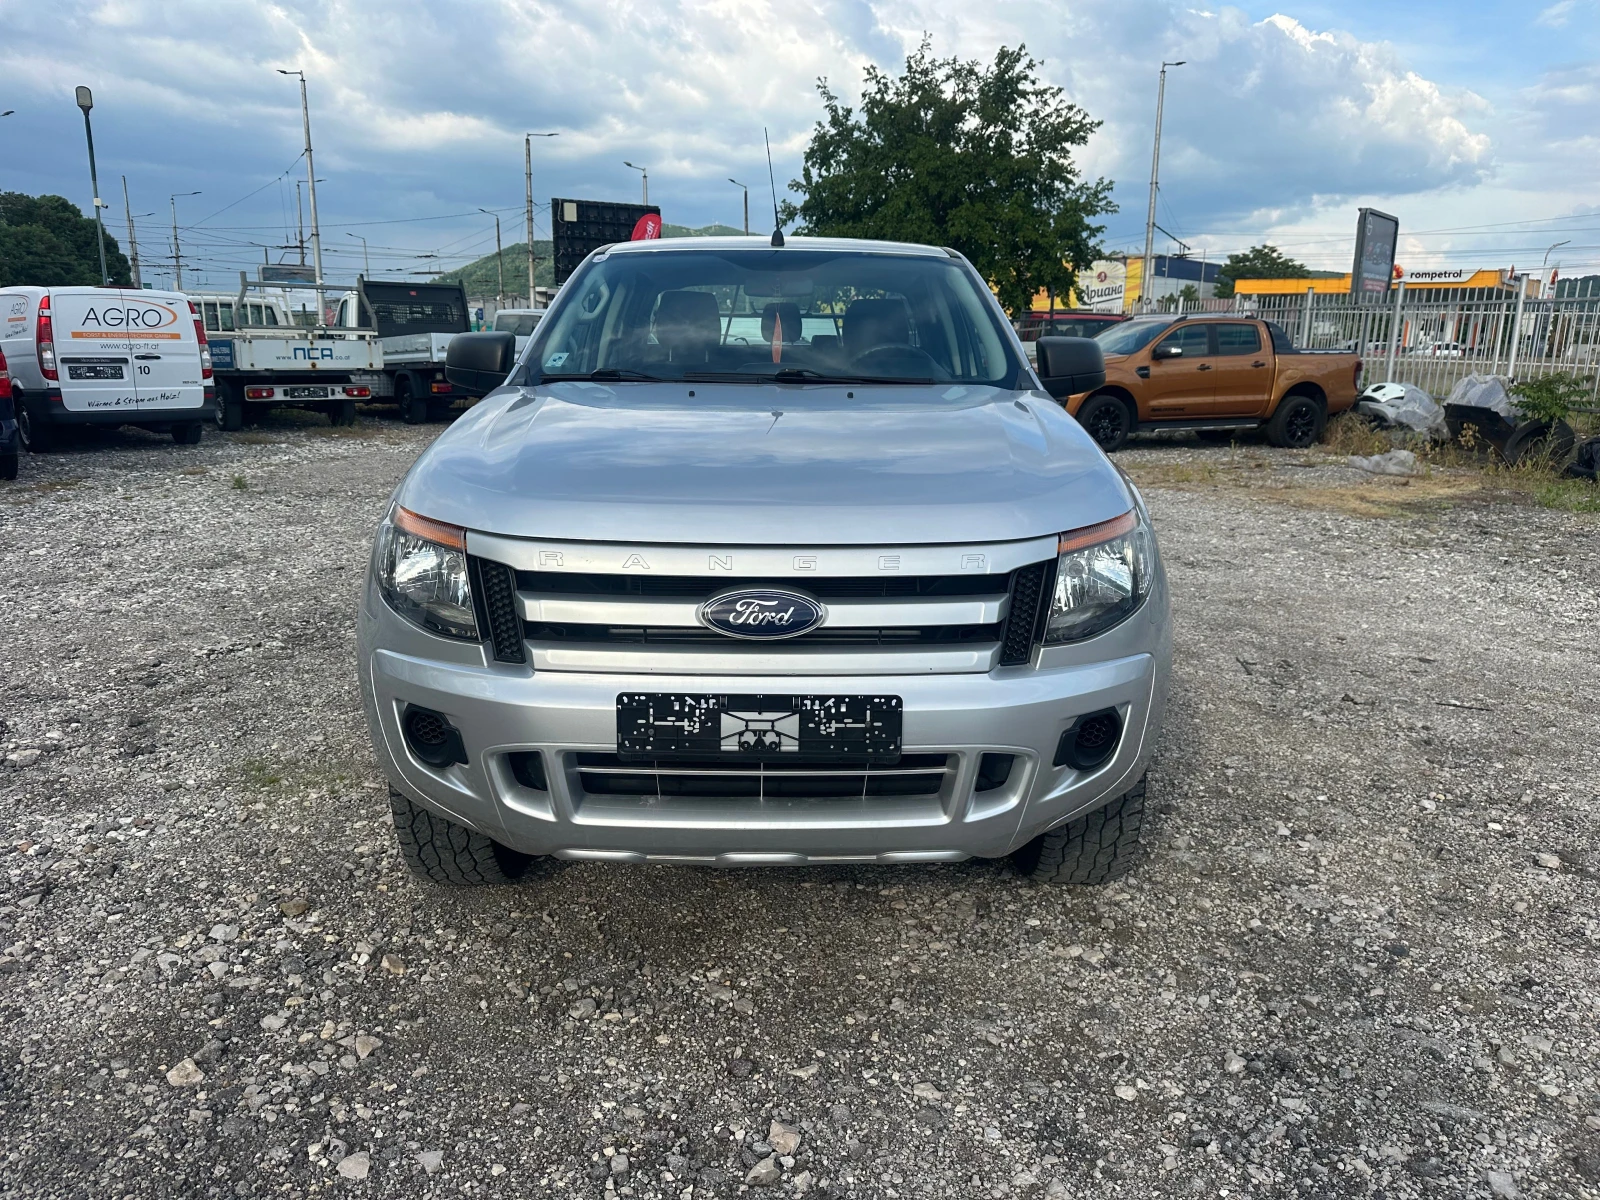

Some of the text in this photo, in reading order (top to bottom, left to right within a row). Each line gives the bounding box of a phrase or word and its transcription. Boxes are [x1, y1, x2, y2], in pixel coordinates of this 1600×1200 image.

[1410, 269, 1462, 281] rompetrol
[1084, 284, 1123, 302] Ариана
[81, 307, 162, 327] AGRO
[100, 342, 159, 351] www.agro-ft.at
[137, 365, 151, 375] 10
[160, 391, 181, 401] Holz!
[538, 550, 986, 571] RANGER
[728, 599, 796, 626] Ford
